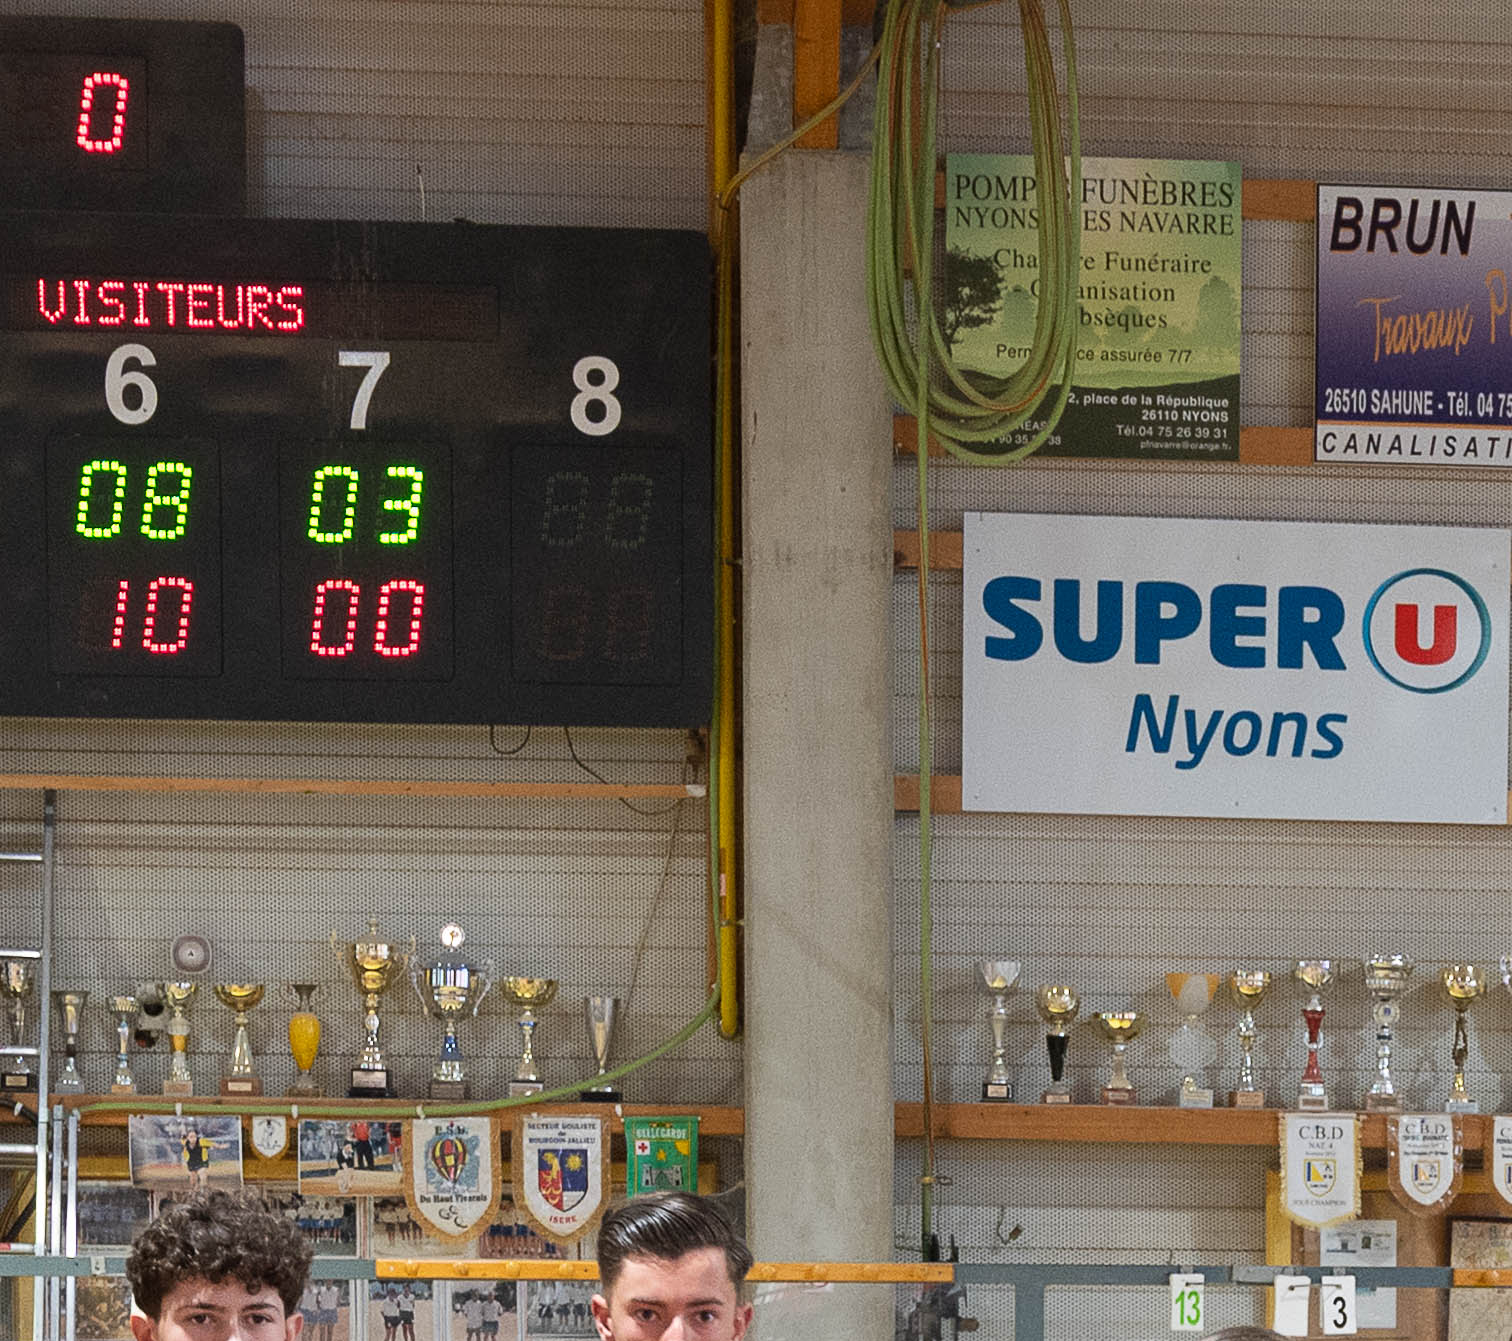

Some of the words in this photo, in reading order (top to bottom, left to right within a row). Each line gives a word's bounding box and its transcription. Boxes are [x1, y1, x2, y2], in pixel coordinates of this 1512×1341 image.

[77, 71, 128, 152] 0
[1082, 173, 1234, 208] FUNÈBRES
[1329, 195, 1475, 257] BRUN
[1104, 251, 1212, 273] Funéraire
[37, 277, 305, 331] VISITEURS
[1362, 296, 1472, 362] Travaux
[1100, 349, 1162, 363] assurée
[1168, 350, 1192, 363] 7/7
[104, 344, 158, 425] 6
[337, 350, 391, 429] 7
[569, 356, 623, 435] 8
[1142, 410, 1178, 421] 26110
[1182, 411, 1228, 422] NYONS
[1325, 388, 1367, 413] 26510
[1371, 389, 1433, 415] SAHUNE
[1447, 392, 1473, 416] Tél.
[1477, 393, 1494, 416] 04
[76, 459, 192, 539] 08
[308, 465, 423, 544] 03
[112, 576, 192, 653] 10
[311, 579, 423, 656] 00
[982, 575, 1347, 671] SUPER
[1394, 603, 1458, 665] U
[1124, 694, 1348, 770] Nyons
[1175, 1290, 1201, 1326] 13
[1333, 1297, 1347, 1328] 3
